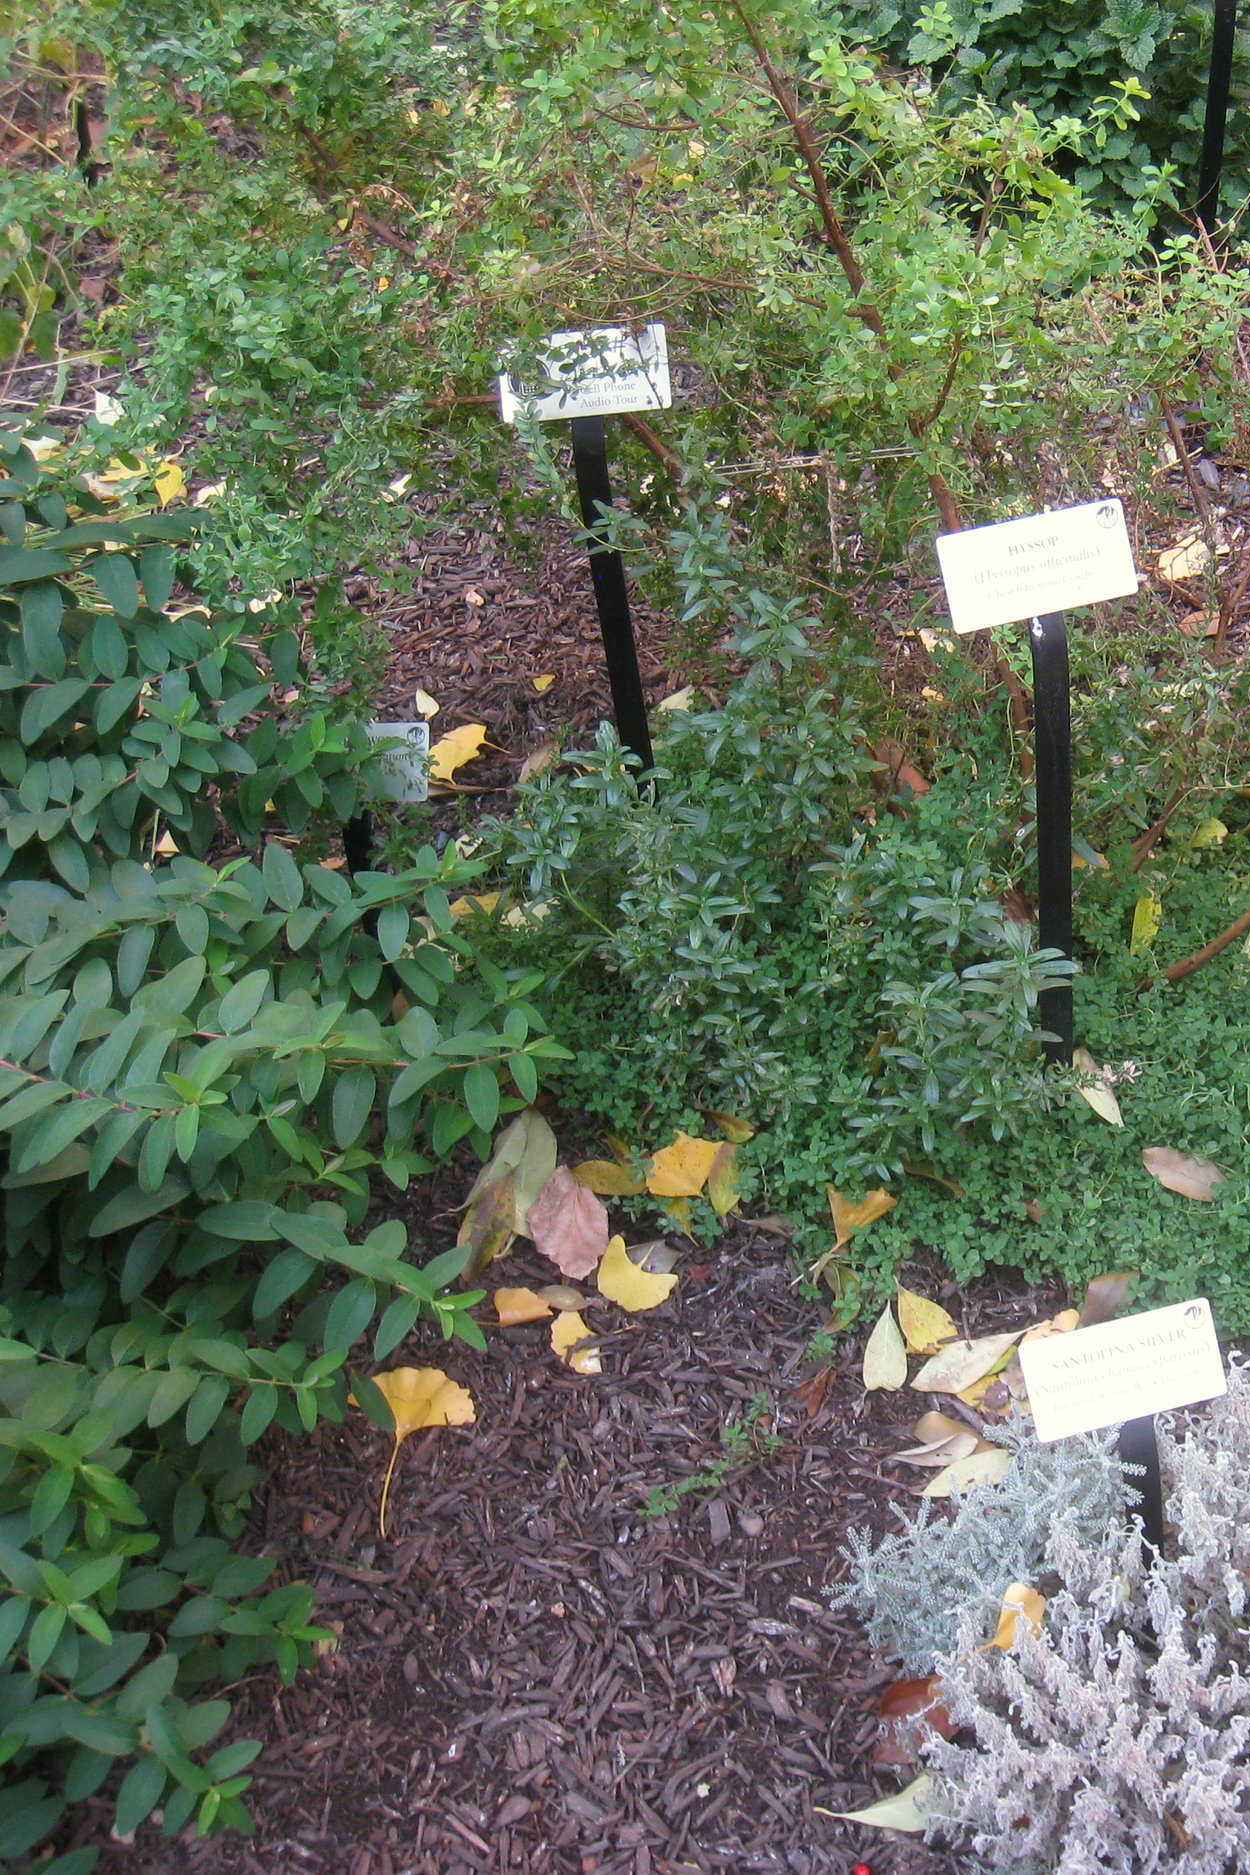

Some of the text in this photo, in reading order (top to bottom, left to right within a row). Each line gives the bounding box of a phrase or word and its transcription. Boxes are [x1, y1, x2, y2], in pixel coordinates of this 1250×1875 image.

[604, 381, 636, 393] Phone
[580, 395, 638, 408] Audio Tour
[1008, 535, 1059, 556] HYSSOP
[1051, 1328, 1187, 1369] SANTOLINA SILVER
